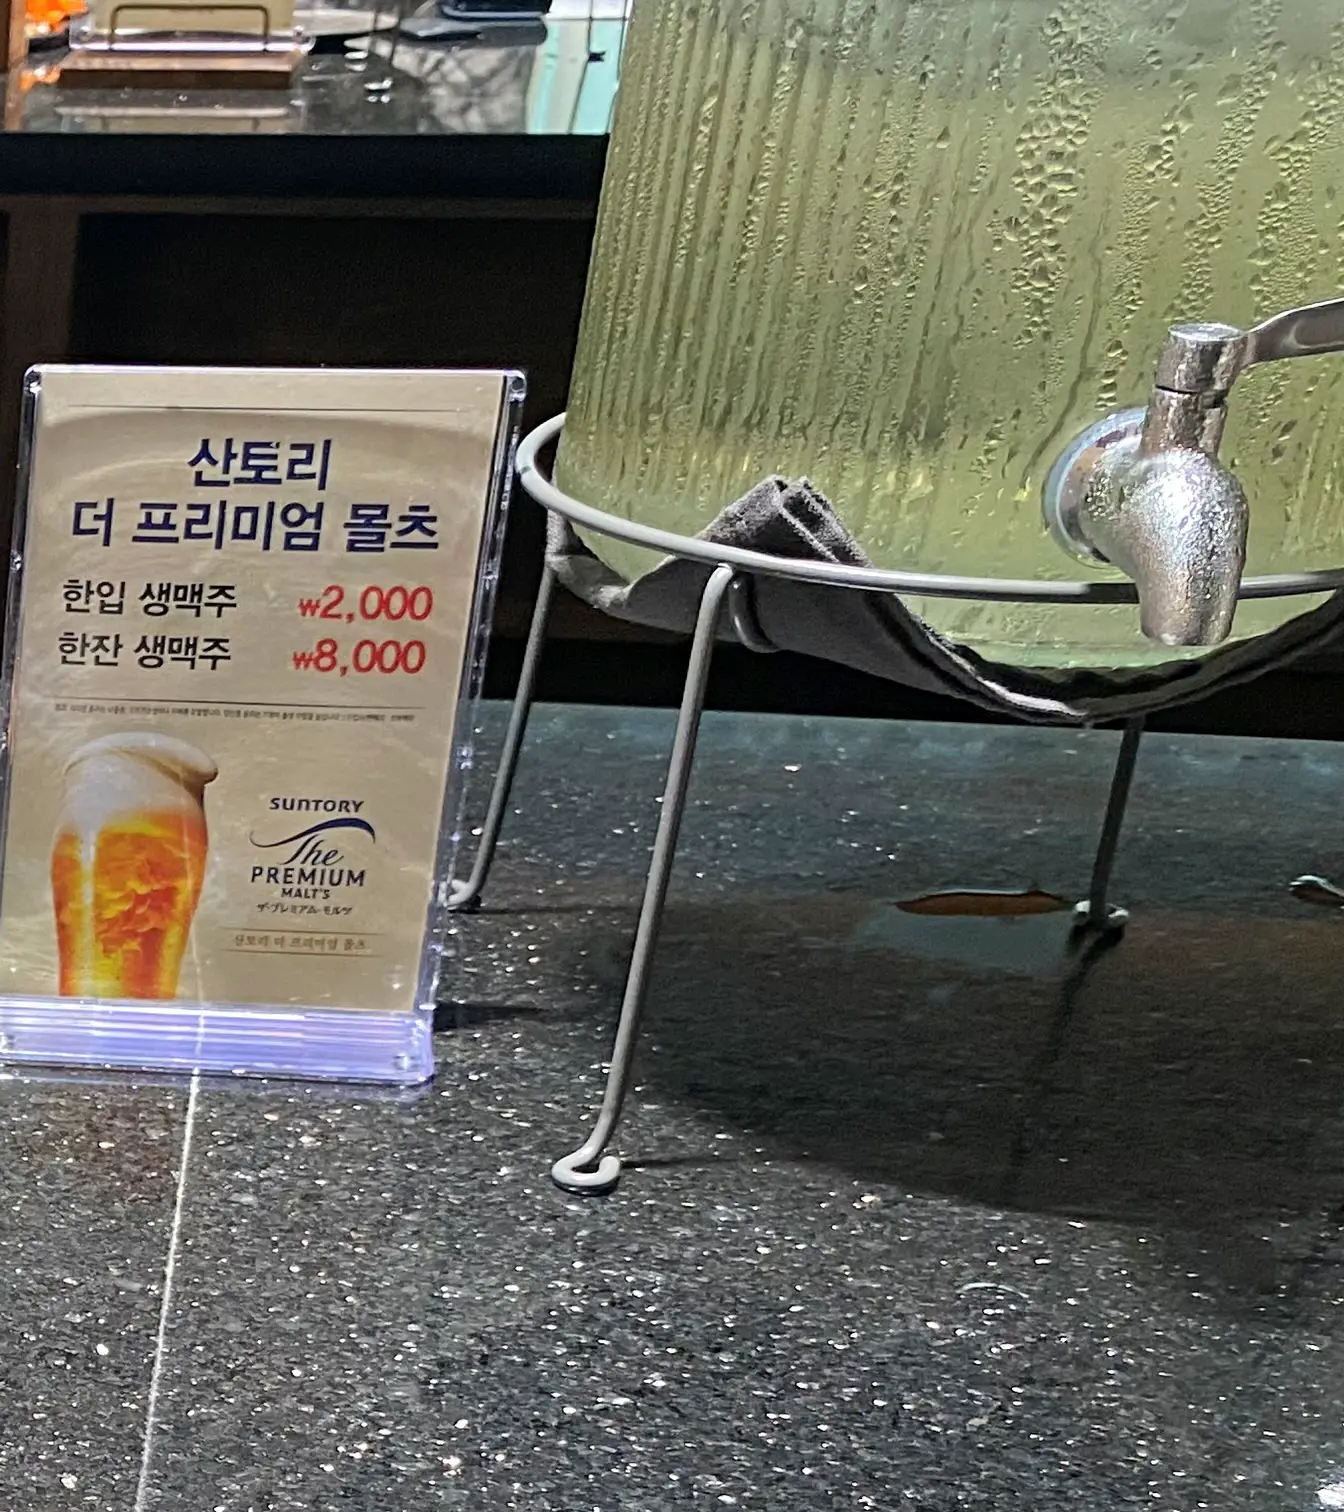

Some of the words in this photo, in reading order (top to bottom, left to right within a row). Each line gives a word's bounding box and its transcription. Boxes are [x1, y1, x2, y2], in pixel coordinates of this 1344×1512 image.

[188, 437, 332, 490] 산토리
[71, 497, 114, 547] 더
[131, 500, 325, 552] 프리미엄
[342, 502, 439, 553] 몰츠
[62, 579, 126, 616] 한입
[137, 581, 237, 619] 생맥주
[57, 632, 123, 667] 한잔
[133, 634, 232, 671] 생맥주
[269, 797, 365, 813] SUNTORY
[278, 833, 345, 866] The
[250, 866, 366, 887] PREMIUM
[281, 887, 331, 900] MALT'S
